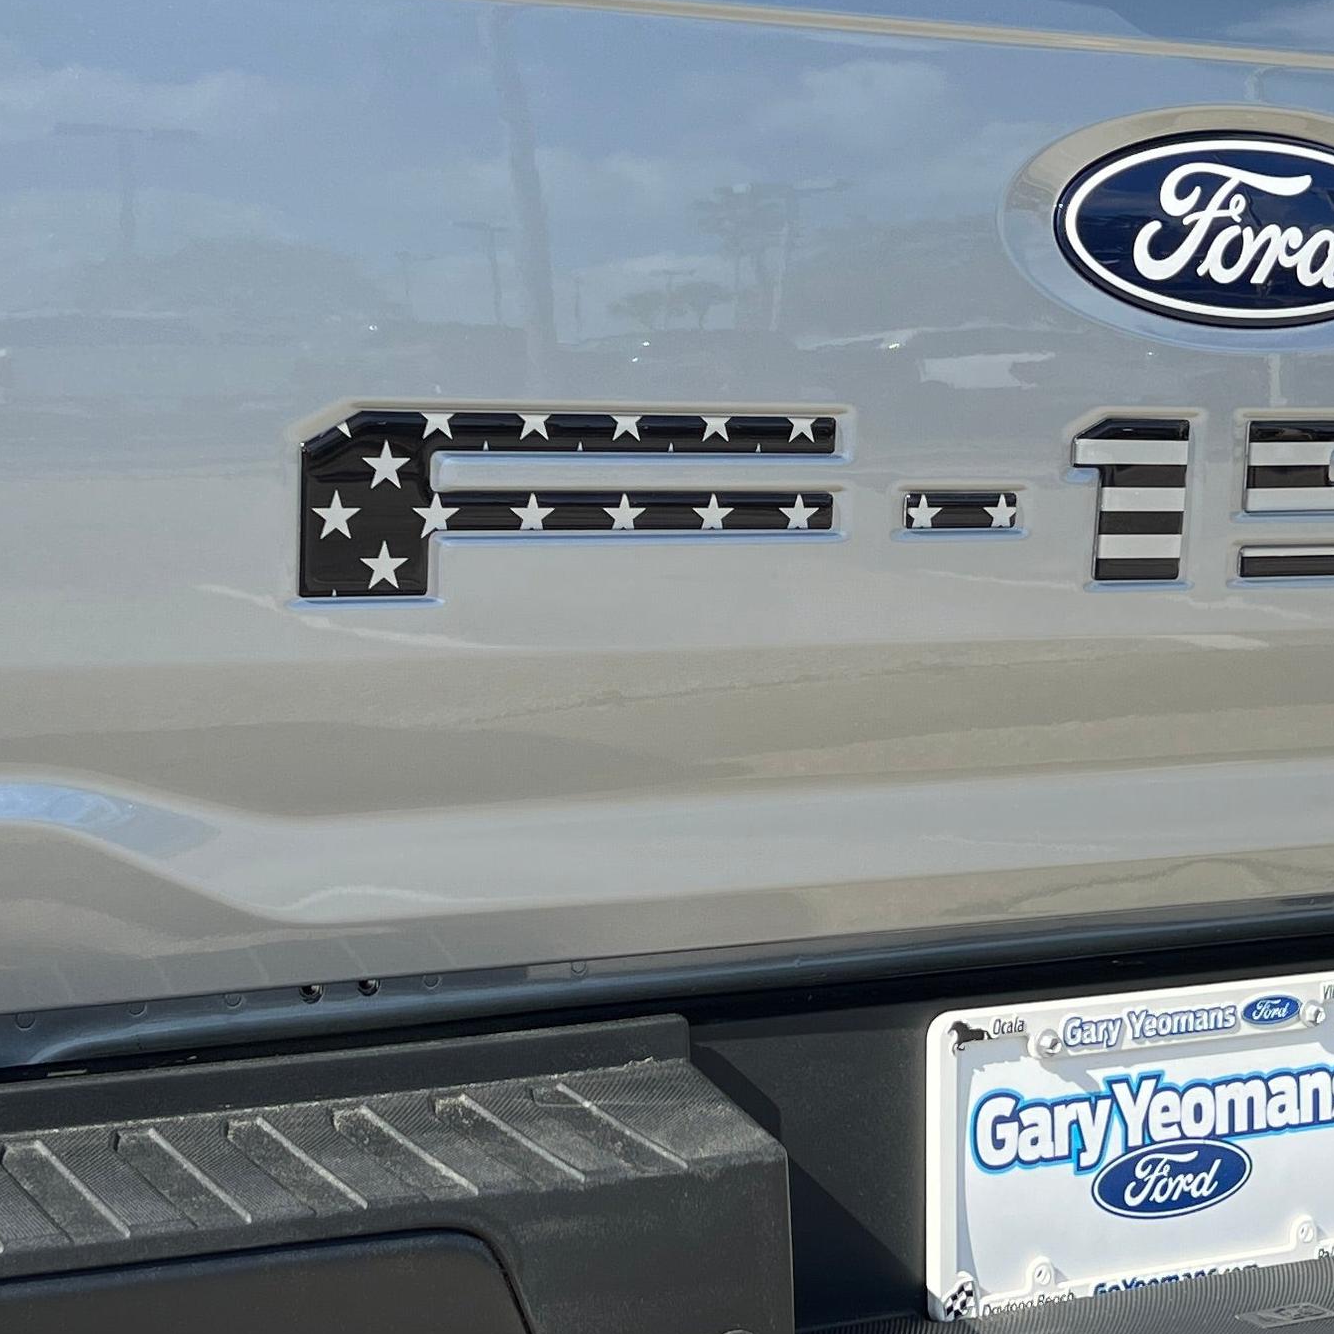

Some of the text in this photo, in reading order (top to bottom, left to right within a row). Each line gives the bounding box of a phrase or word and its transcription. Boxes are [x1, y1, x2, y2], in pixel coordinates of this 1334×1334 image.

[992, 1017, 1025, 1035] Ocala
[1063, 998, 1291, 1048] Gary Yeomans Ford
[1124, 1150, 1219, 1206] Ford
